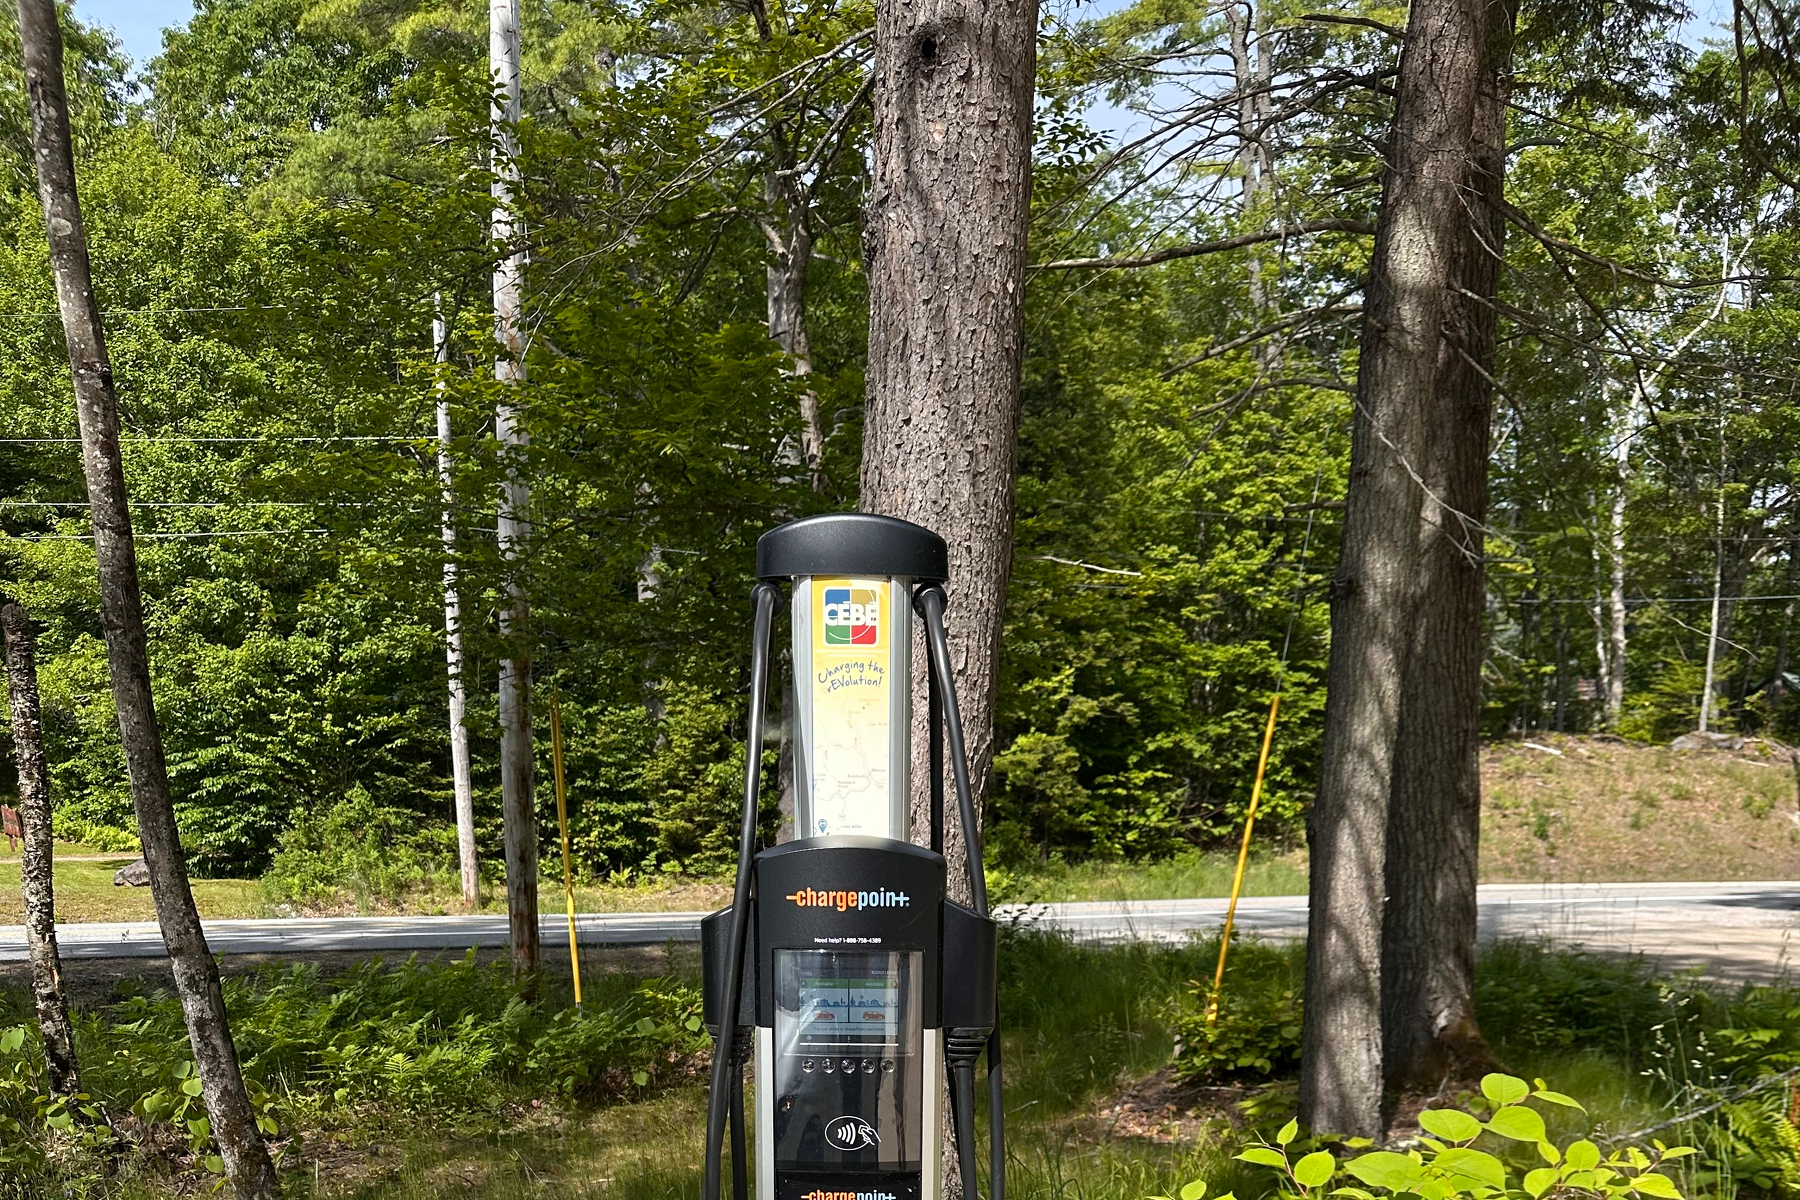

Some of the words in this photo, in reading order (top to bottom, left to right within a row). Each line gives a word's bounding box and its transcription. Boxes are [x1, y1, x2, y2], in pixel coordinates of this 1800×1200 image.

[818, 660, 864, 683] Charging
[868, 660, 885, 674] the
[827, 675, 882, 693] rEVolution!
